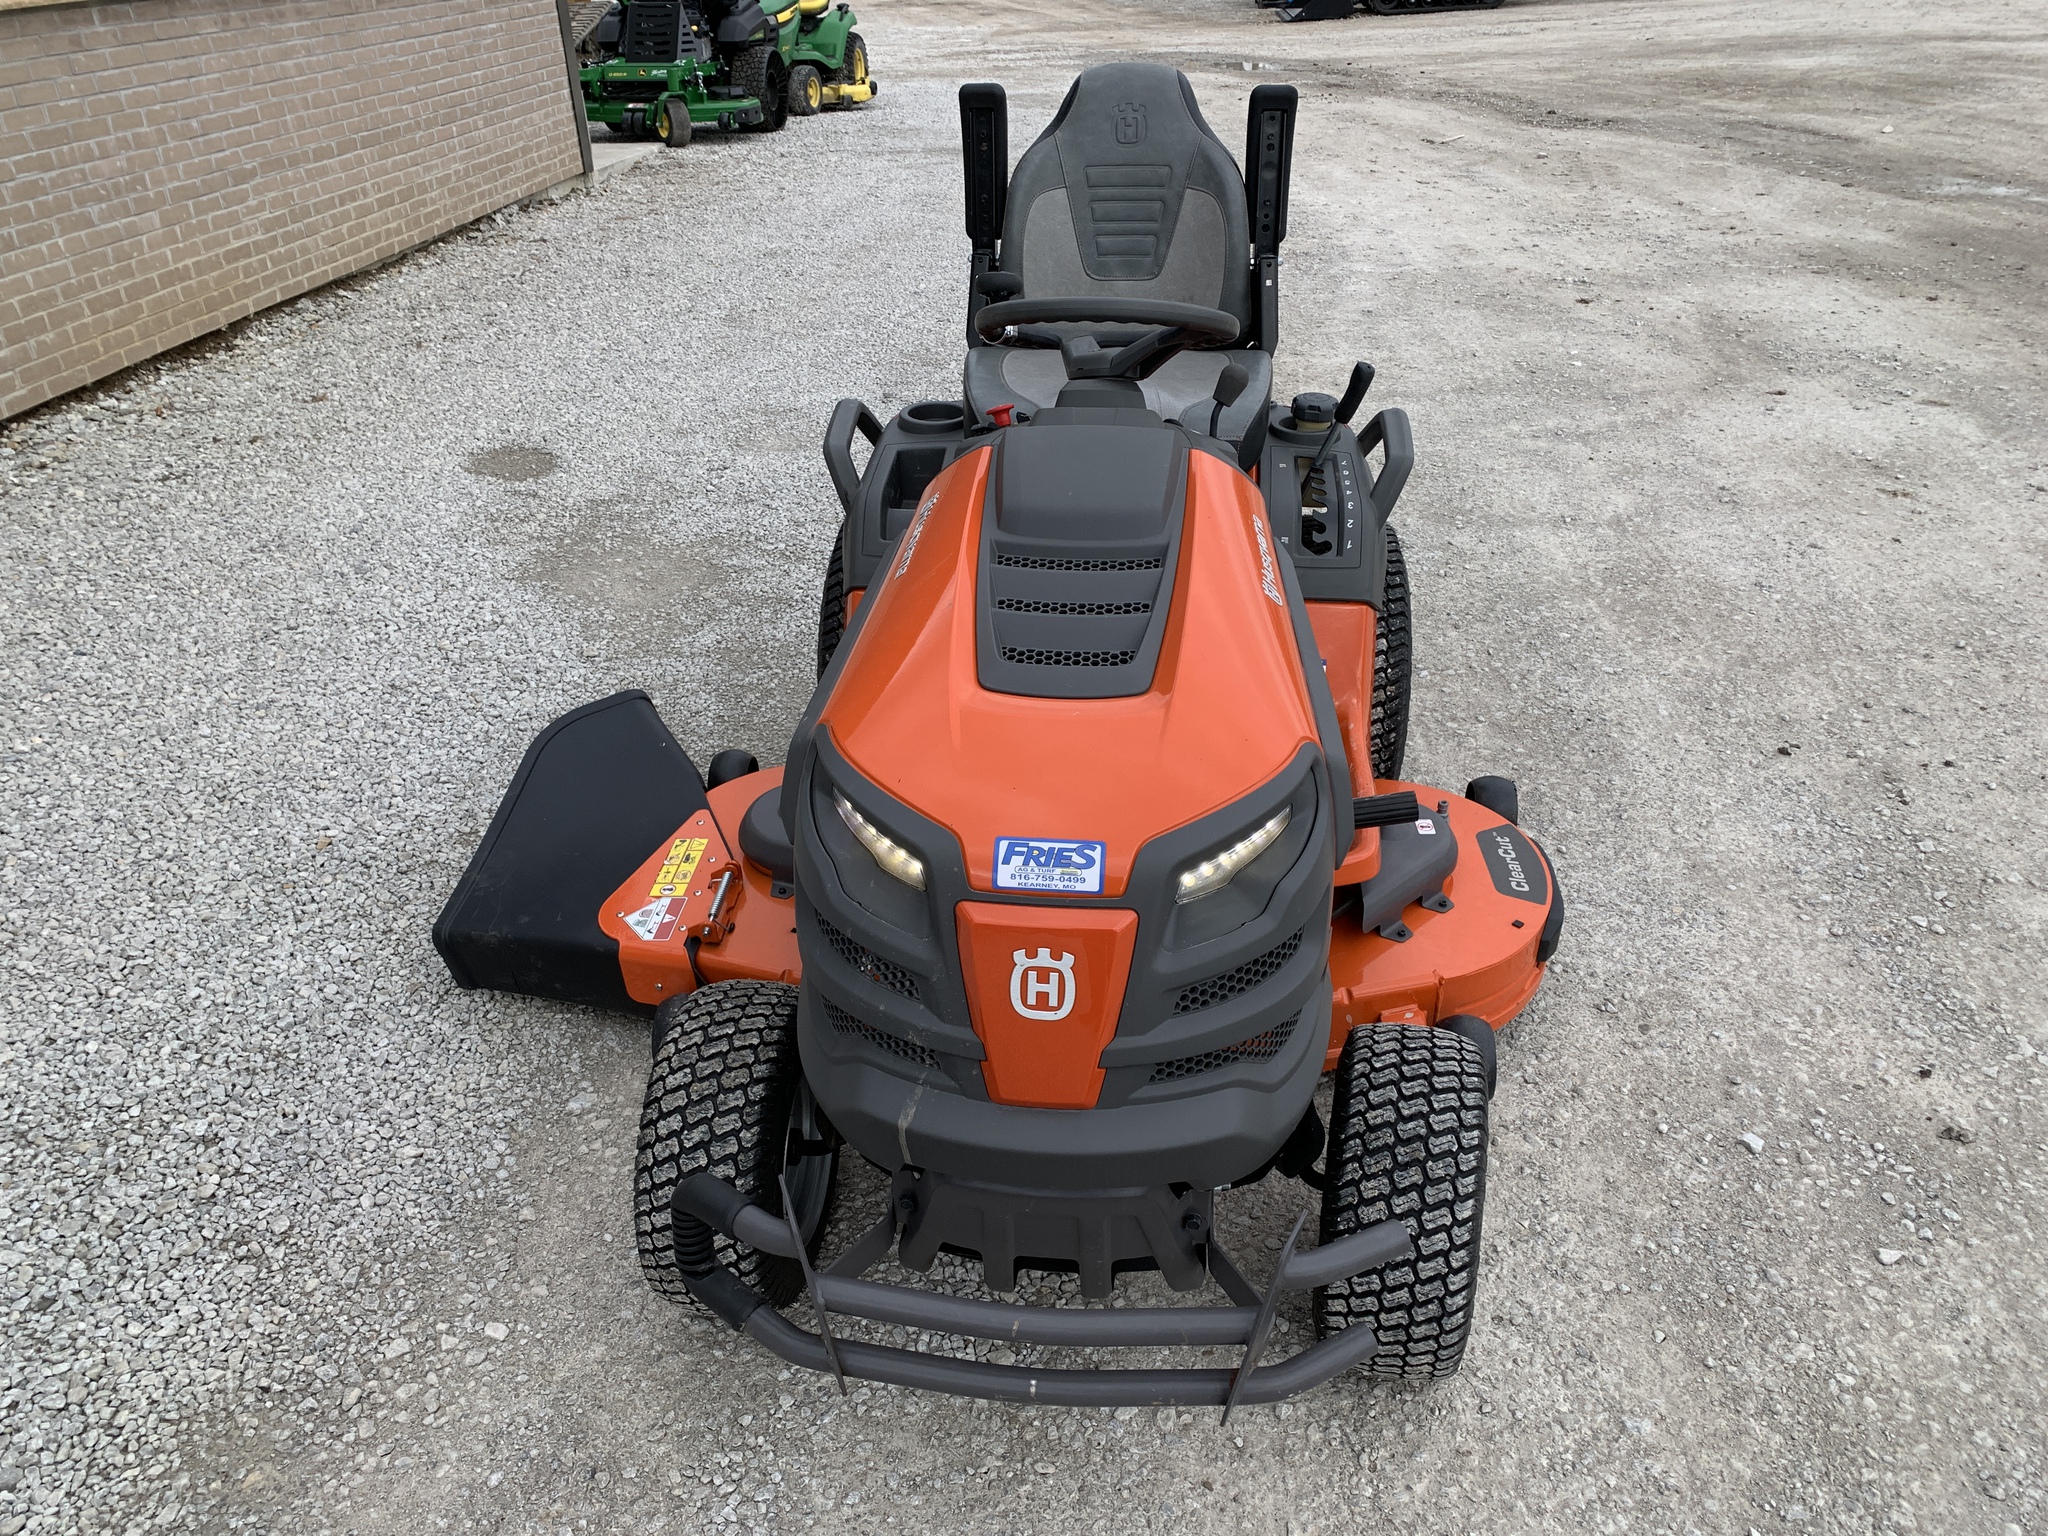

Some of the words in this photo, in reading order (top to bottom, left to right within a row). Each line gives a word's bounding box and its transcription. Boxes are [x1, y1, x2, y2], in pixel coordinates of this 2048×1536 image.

[1347, 501, 1354, 510] 3
[1346, 519, 1354, 528] 2
[1346, 540, 1353, 550] 1
[1001, 842, 1098, 870] FRIES
[1494, 835, 1530, 892] ClearCut
[1010, 873, 1086, 884] 816-759-0499
[1026, 970, 1060, 1007] H
